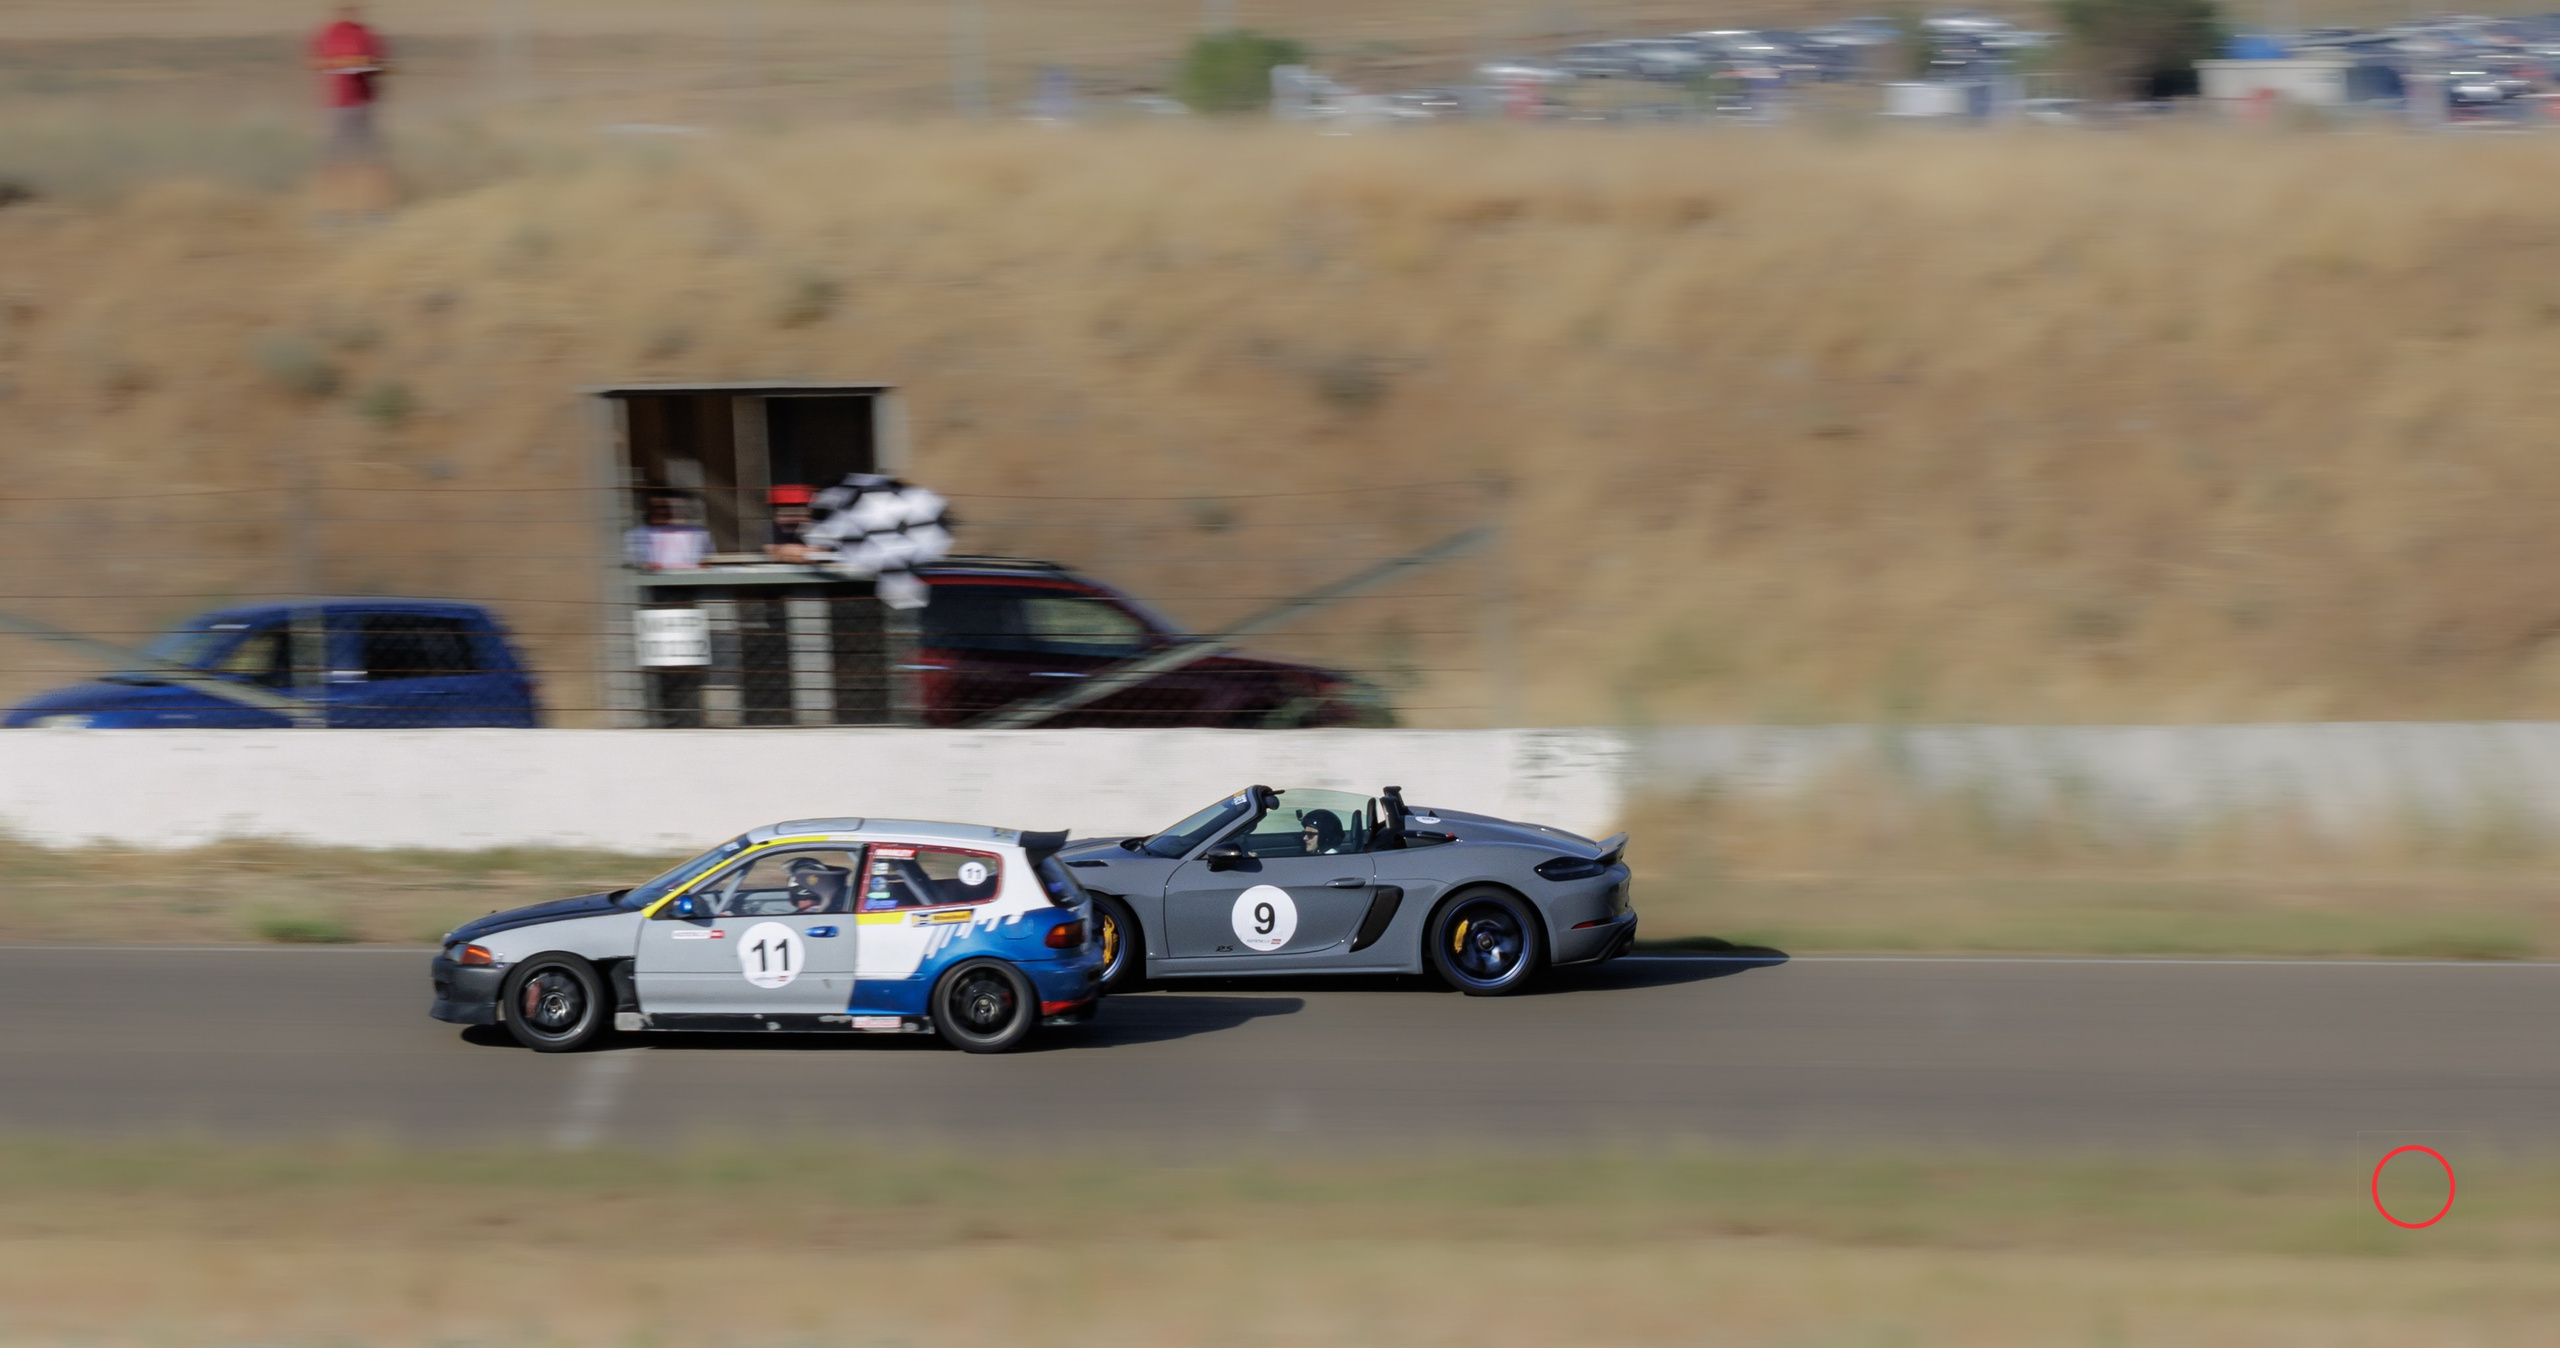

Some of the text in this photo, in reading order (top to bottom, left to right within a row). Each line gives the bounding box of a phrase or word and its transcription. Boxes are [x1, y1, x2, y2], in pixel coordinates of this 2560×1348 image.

[965, 868, 982, 880] 11
[1254, 902, 1275, 935] 9
[751, 939, 789, 972] 11
